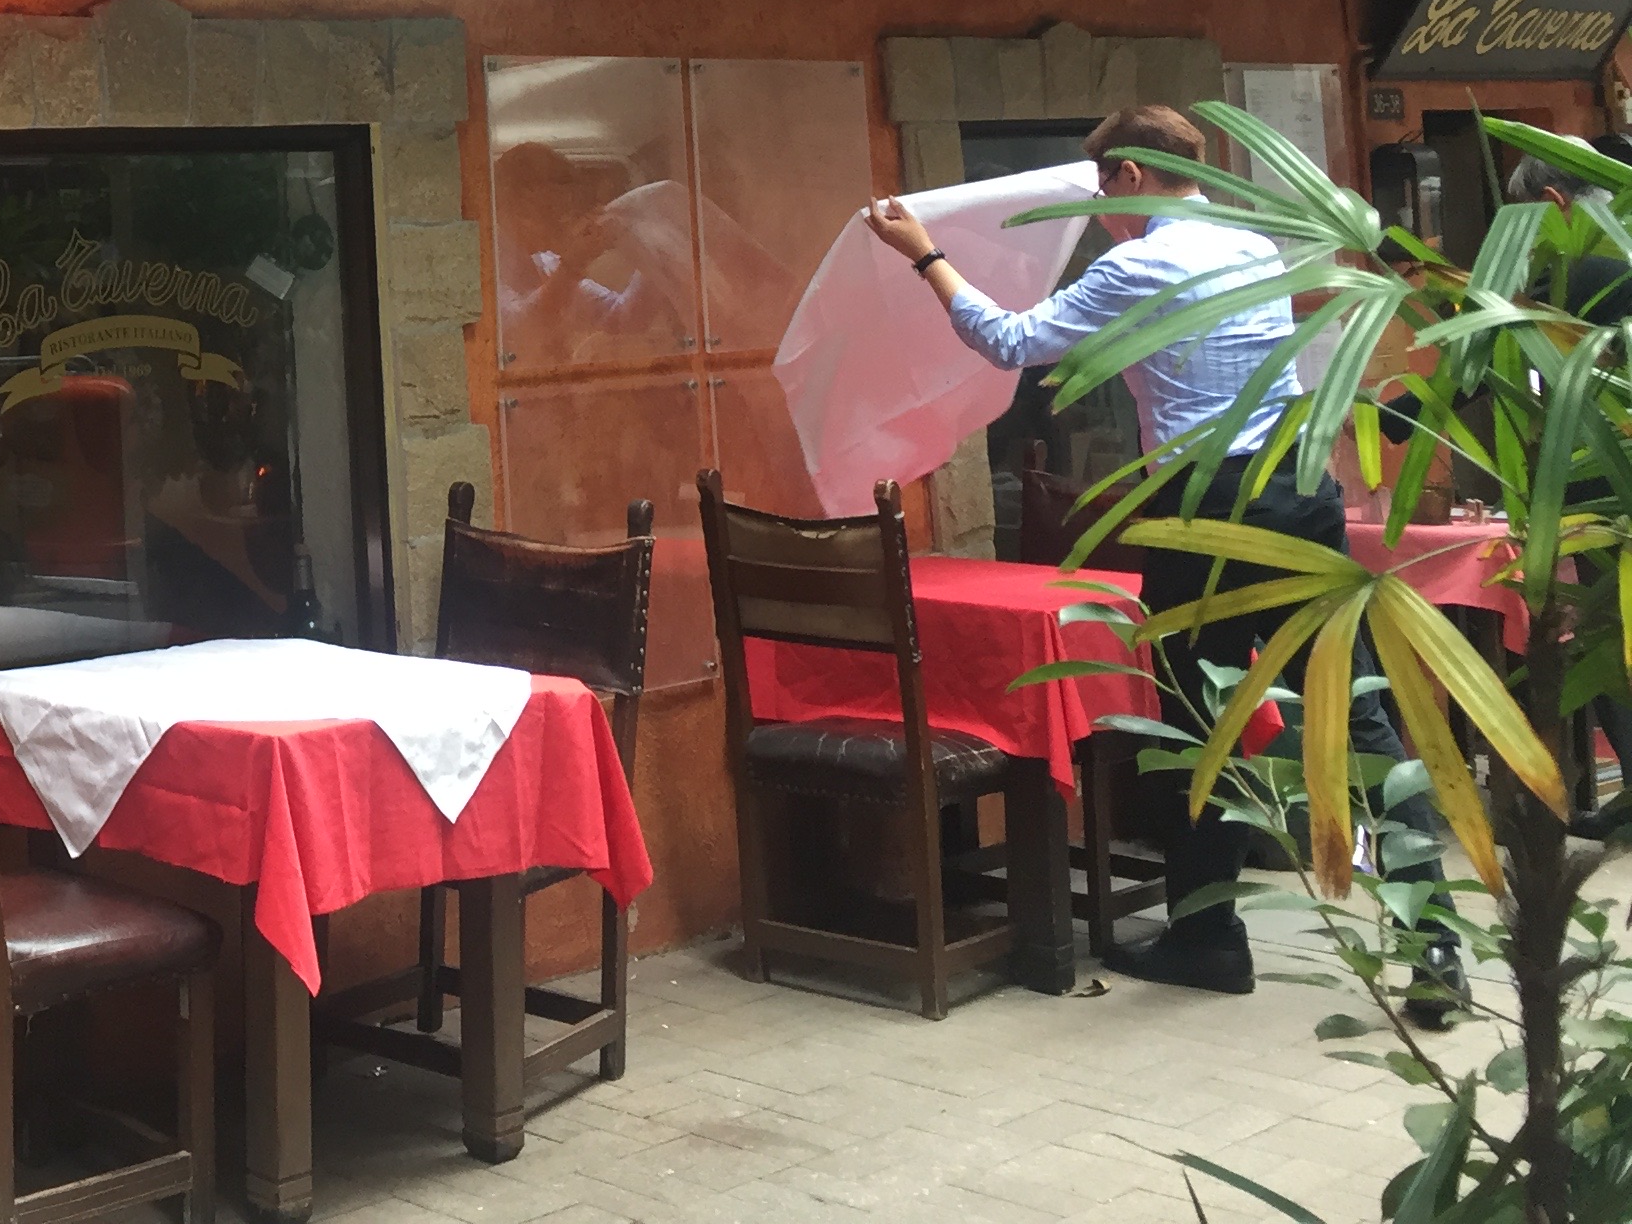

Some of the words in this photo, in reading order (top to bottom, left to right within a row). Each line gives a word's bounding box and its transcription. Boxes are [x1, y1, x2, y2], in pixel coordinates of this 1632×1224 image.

[55, 227, 259, 327] Taverna
[48, 327, 128, 356] RISTORANTE
[133, 327, 193, 343] ITALIANO
